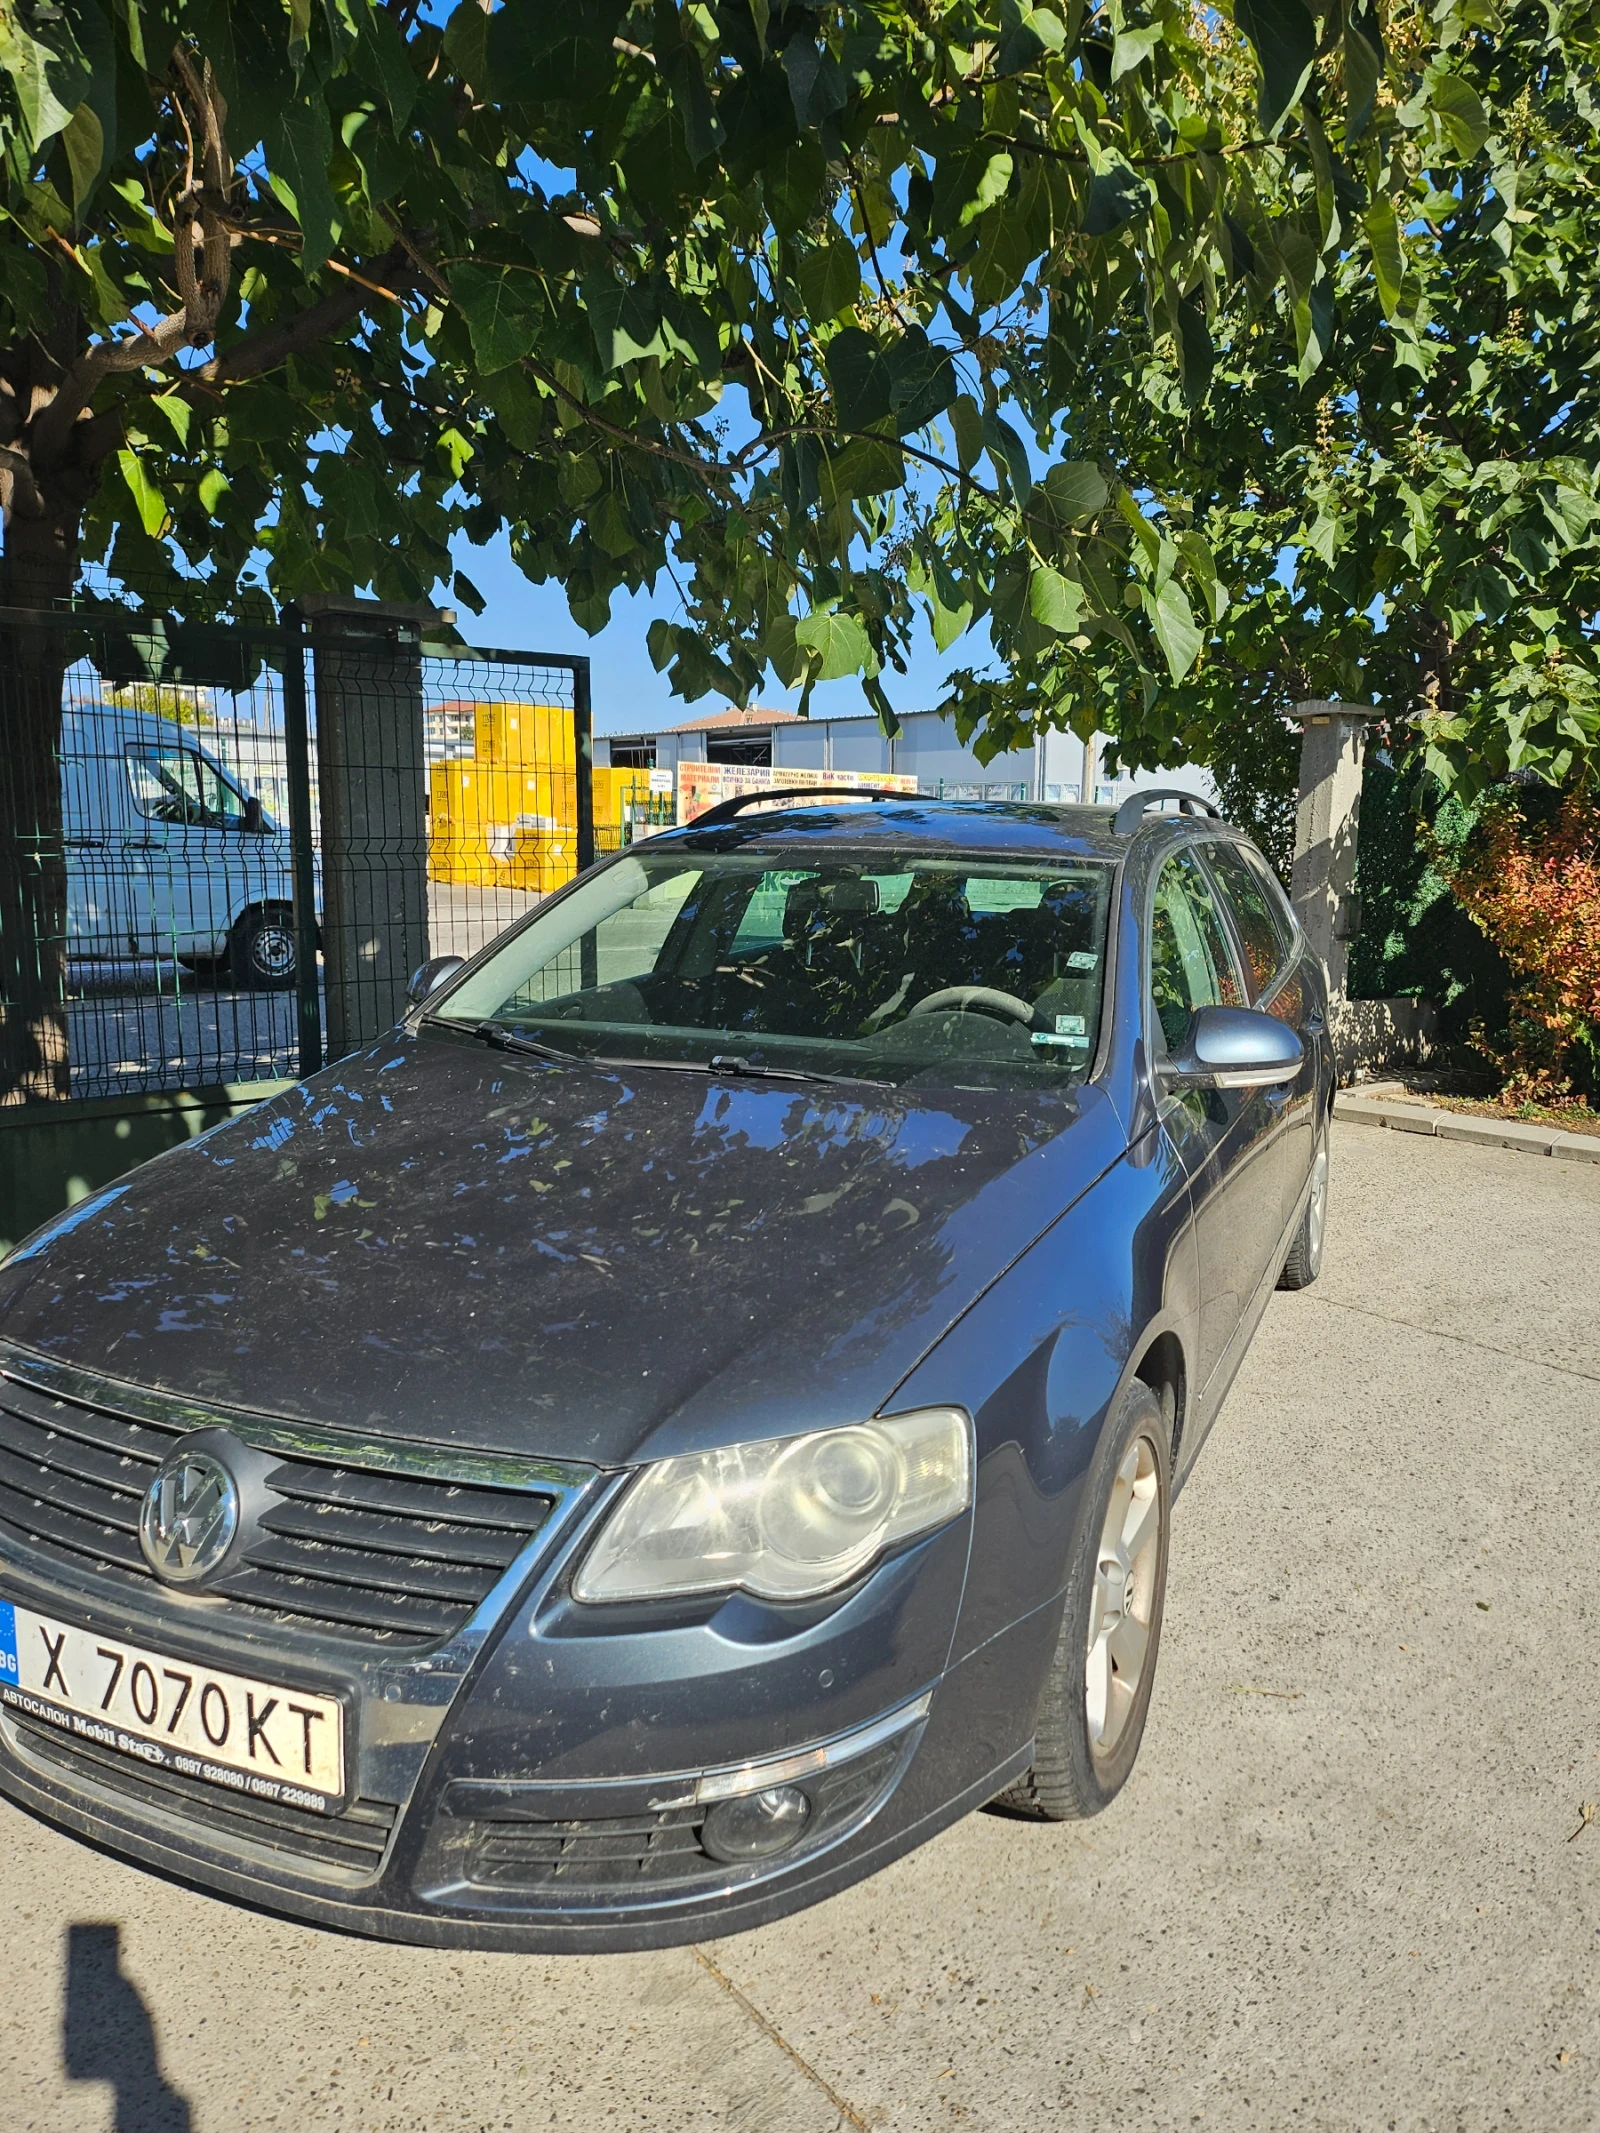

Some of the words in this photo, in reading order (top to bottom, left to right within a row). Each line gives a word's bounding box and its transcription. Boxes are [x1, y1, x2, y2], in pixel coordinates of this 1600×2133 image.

[680, 763, 720, 774] СТРОИТЕЛНИ
[724, 766, 771, 777] ЖЕЛЕЗАРИЯ
[680, 774, 720, 784] МАТЕРИАЛИ
[0, 1649, 16, 1672] BG
[39, 1624, 71, 1697] X
[3, 1688, 70, 1727] АВТОСАЛОН
[72, 1715, 116, 1746] Mobil
[175, 1755, 201, 1775] 0897
[203, 1764, 244, 1788] 928080
[251, 1778, 280, 1798] 0897
